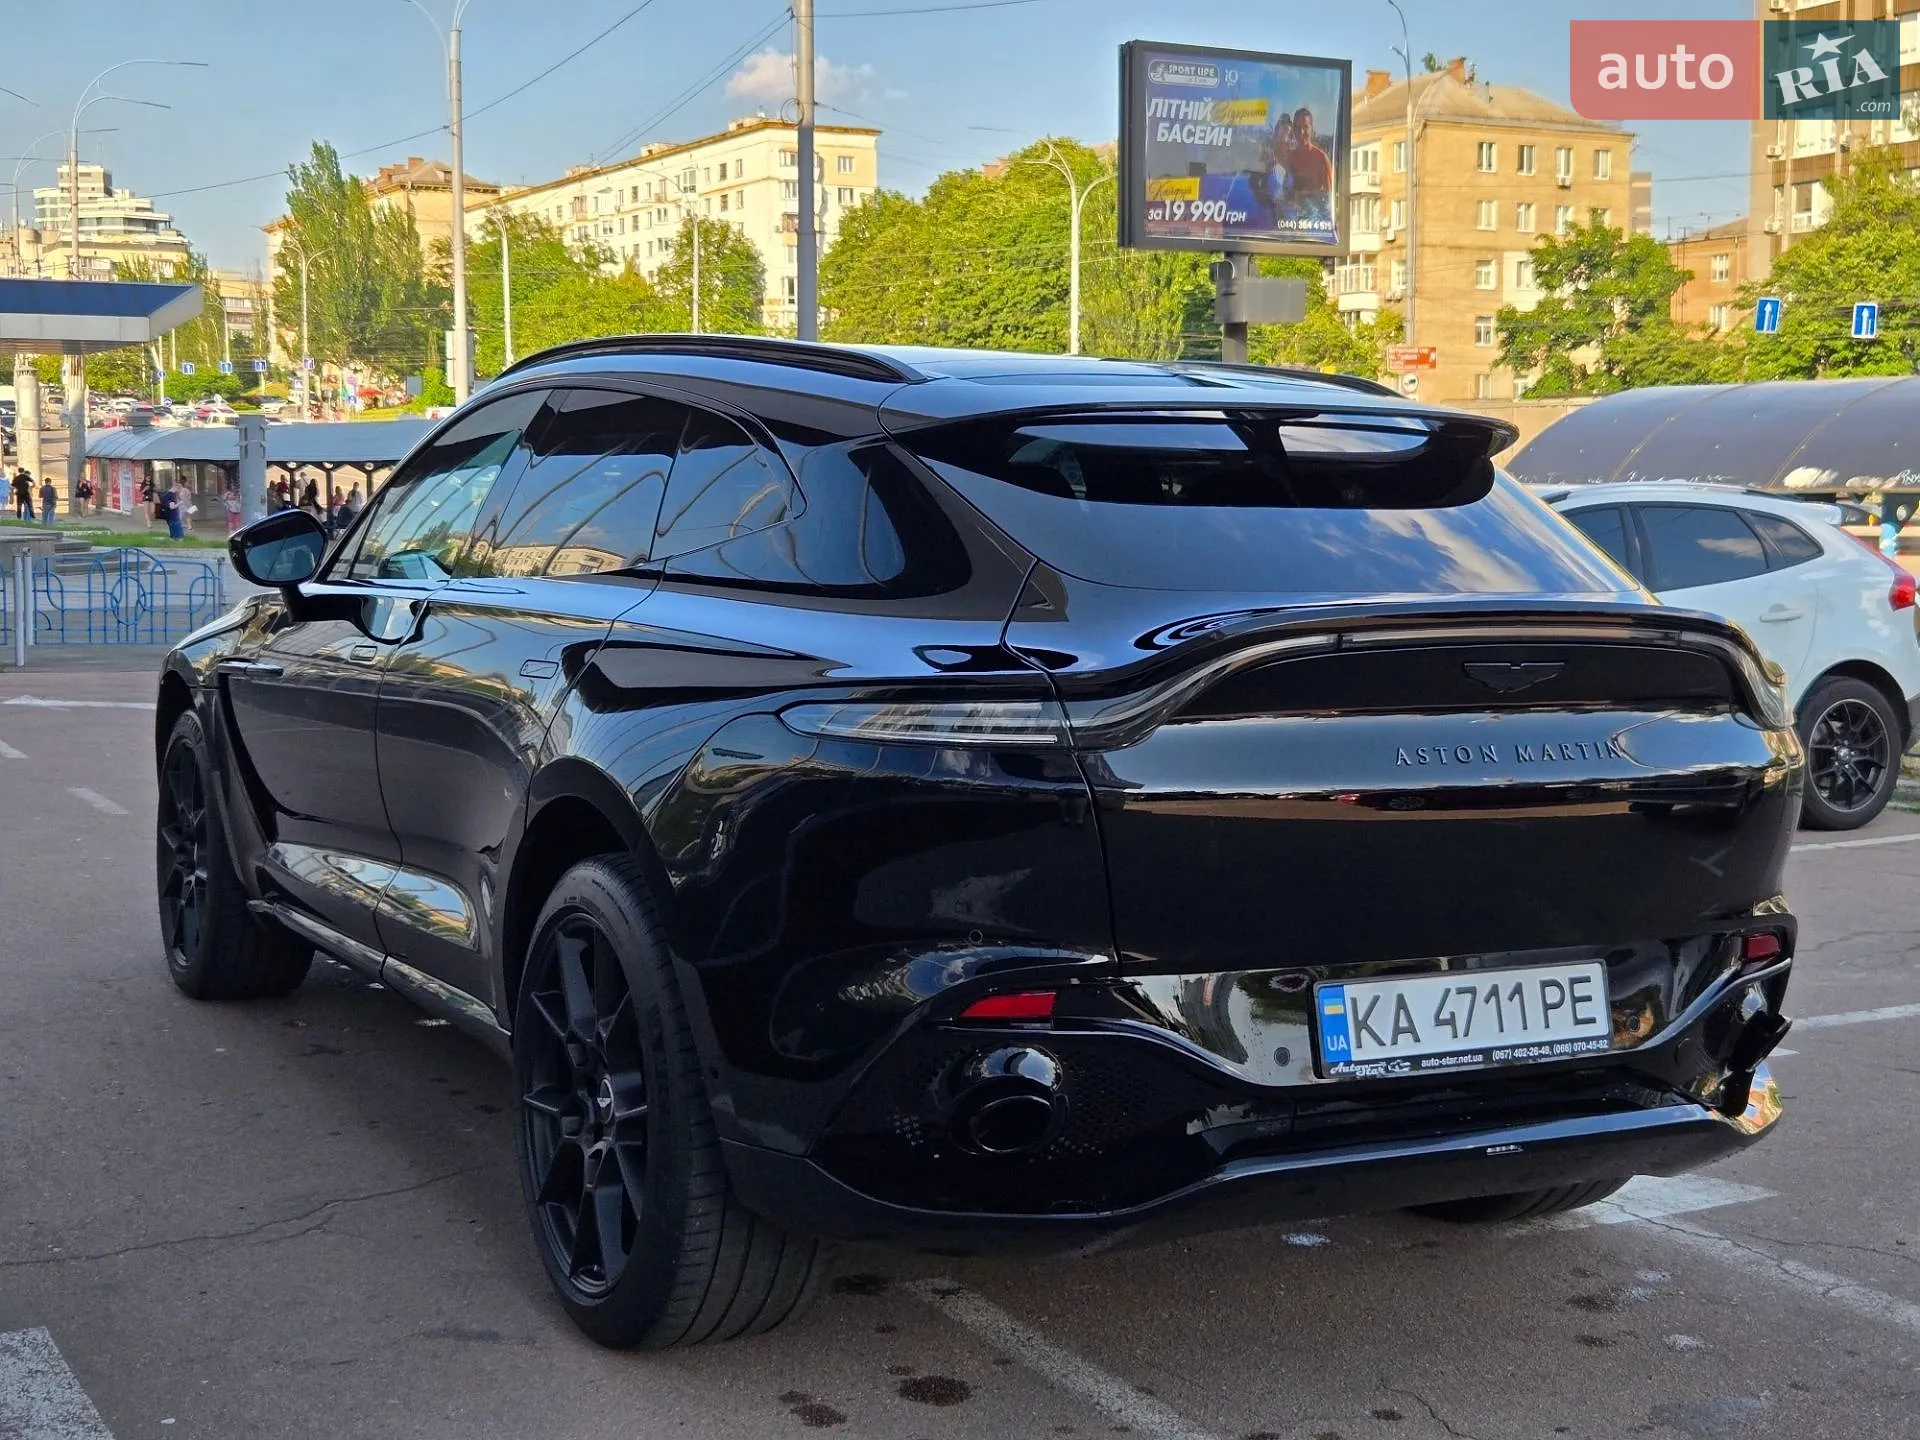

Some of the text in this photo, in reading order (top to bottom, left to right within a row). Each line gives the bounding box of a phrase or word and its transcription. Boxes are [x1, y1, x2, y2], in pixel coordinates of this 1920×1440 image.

[1168, 63, 1215, 78] SPORT LIFE
[1147, 97, 1215, 121] ЛІТНІЙ
[1156, 121, 1233, 147] БАСЕЙН
[1147, 200, 1247, 224] за 19 990 грн
[1277, 219, 1297, 230] (044)
[1395, 739, 1624, 767] ASTON MARTIN
[1349, 975, 1597, 1049] KA 4711 PE
[1326, 1034, 1348, 1051] UA
[1421, 1053, 1484, 1068] auto-star.net.ua
